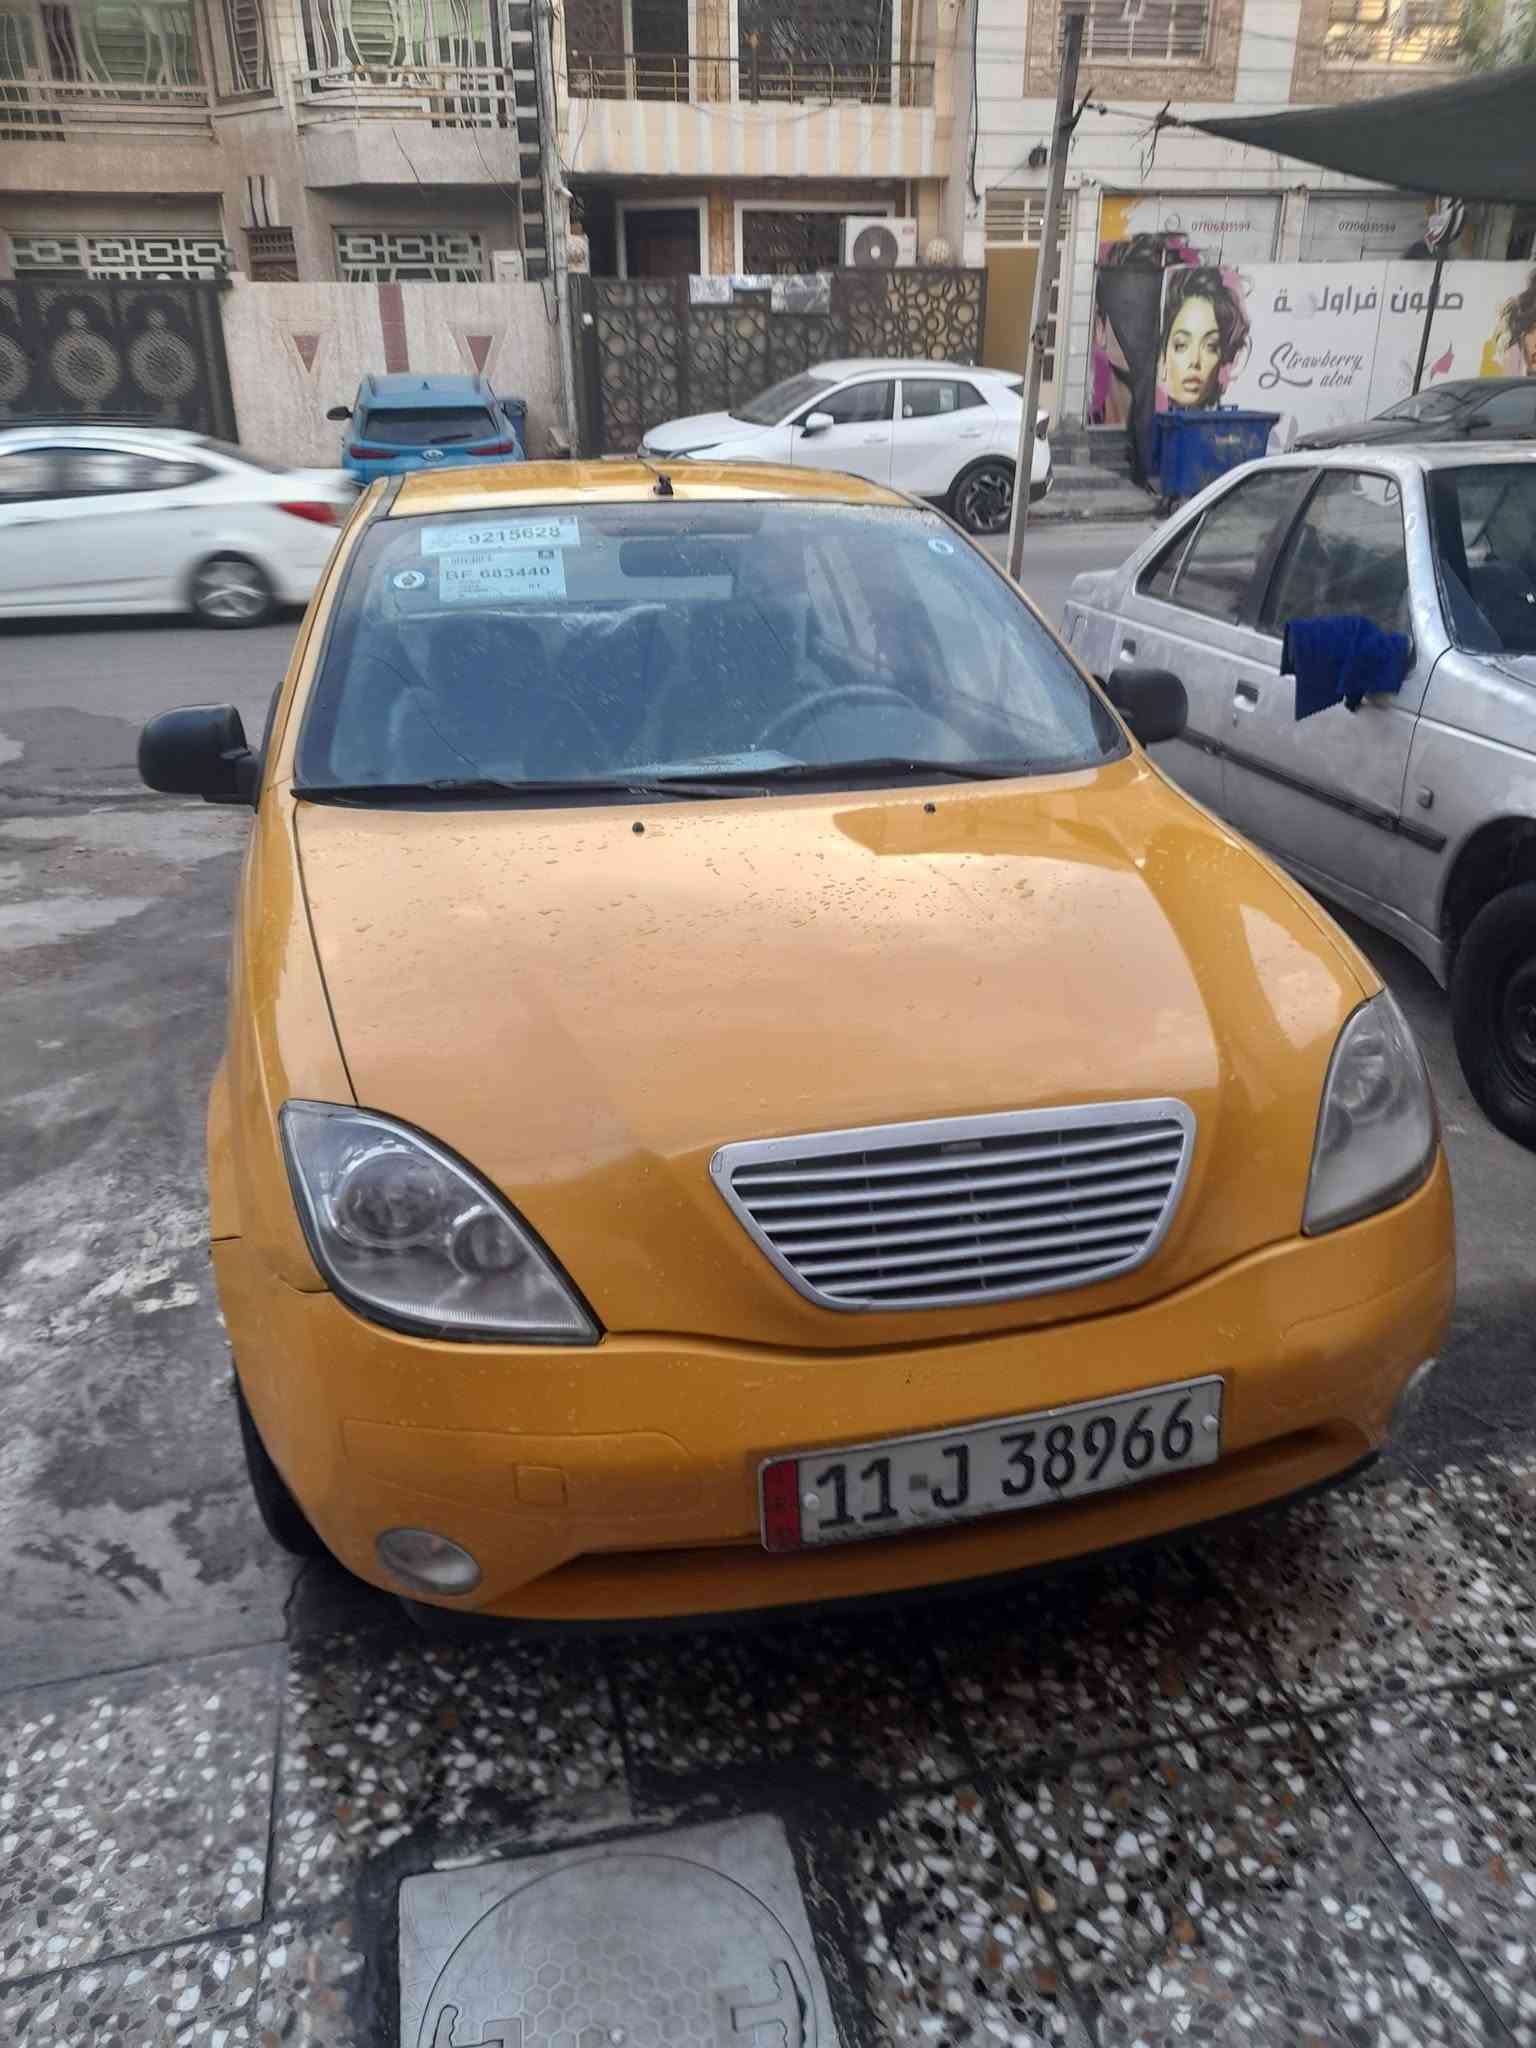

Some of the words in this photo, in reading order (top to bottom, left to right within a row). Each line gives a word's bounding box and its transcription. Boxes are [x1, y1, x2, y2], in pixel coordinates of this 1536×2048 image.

[1258, 341, 1364, 390] Strawberry
[815, 1457, 899, 1530] 11
[930, 1444, 970, 1509] J
[1001, 1398, 1194, 1497] 38966
